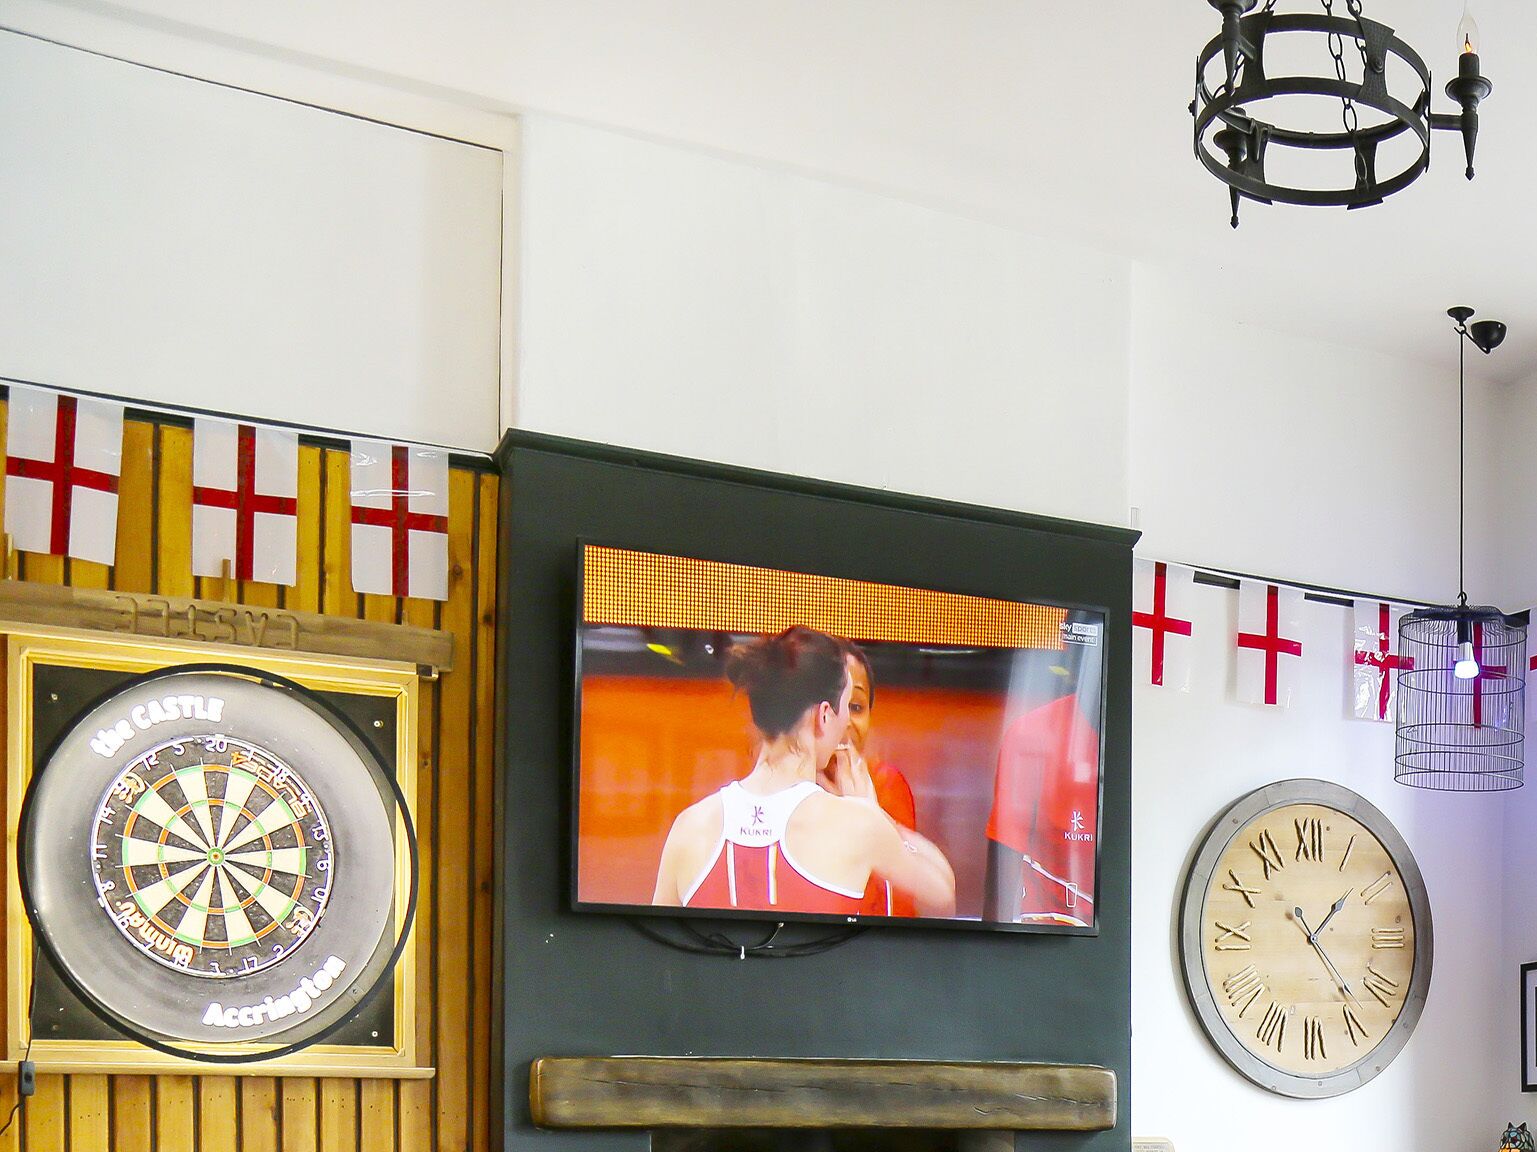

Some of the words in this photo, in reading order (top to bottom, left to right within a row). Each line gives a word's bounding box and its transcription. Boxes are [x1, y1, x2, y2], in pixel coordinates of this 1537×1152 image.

[114, 594, 300, 650] CASTLE
[89, 719, 136, 758] the
[131, 695, 225, 730] CASTLE
[205, 737, 228, 753] 20
[141, 752, 160, 771] 12
[100, 806, 116, 825] 14
[1064, 831, 1093, 842] KUKRI
[1294, 816, 1324, 862] XII
[99, 880, 116, 894] 8
[311, 887, 328, 903] 10
[240, 956, 258, 974] 17
[202, 955, 347, 1028] Accrington
